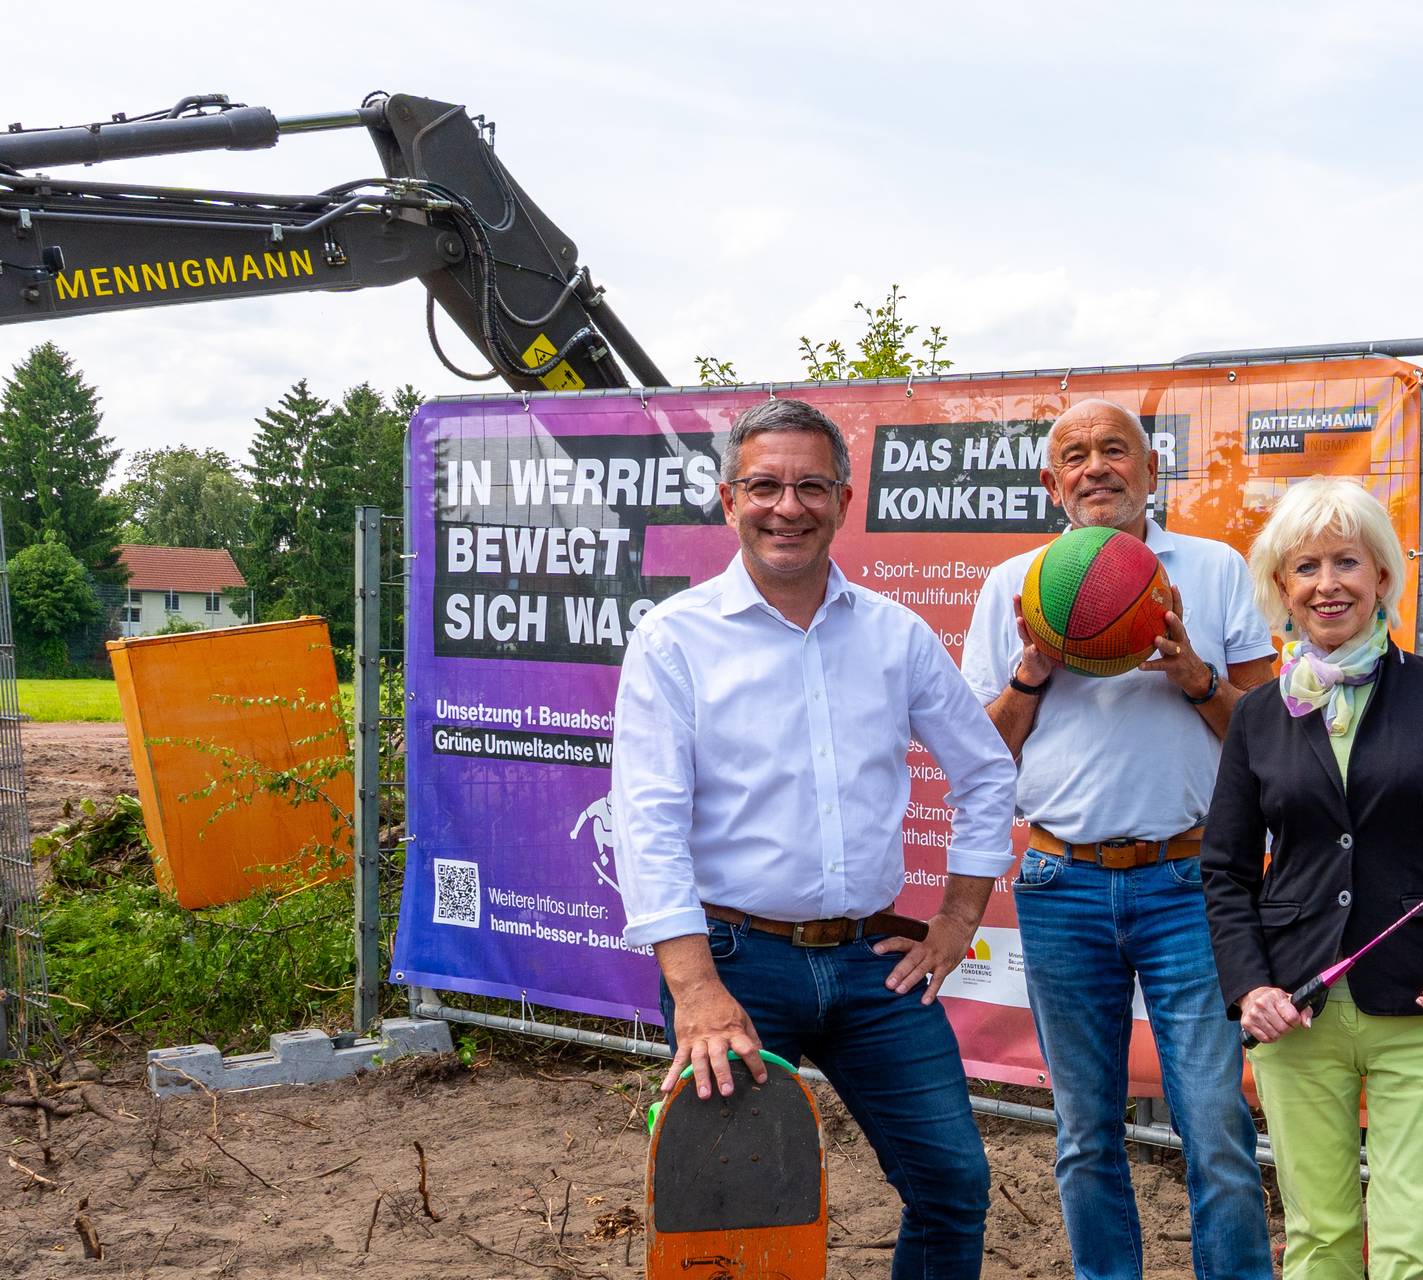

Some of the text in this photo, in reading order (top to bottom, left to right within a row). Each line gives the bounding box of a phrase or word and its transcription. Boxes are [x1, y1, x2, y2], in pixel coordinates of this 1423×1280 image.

[56, 249, 314, 299] MENNIGMANN
[1252, 413, 1372, 431] DATTELN-HAMM
[882, 438, 952, 472] DAS
[1250, 434, 1299, 449] KANAL
[447, 455, 717, 506] IN WERRIES
[877, 486, 1051, 520] KONKRET
[447, 527, 630, 576] BEWEGT
[874, 560, 919, 581] Sport-
[922, 561, 951, 579] und
[902, 587, 983, 606] multifunkt
[444, 593, 548, 642] SICH
[435, 699, 522, 728] Umsetzung
[525, 705, 537, 725] 1.
[435, 729, 482, 753] Grüne
[484, 733, 593, 763] Umweltachse
[488, 886, 609, 920] Weitere Infos unter:
